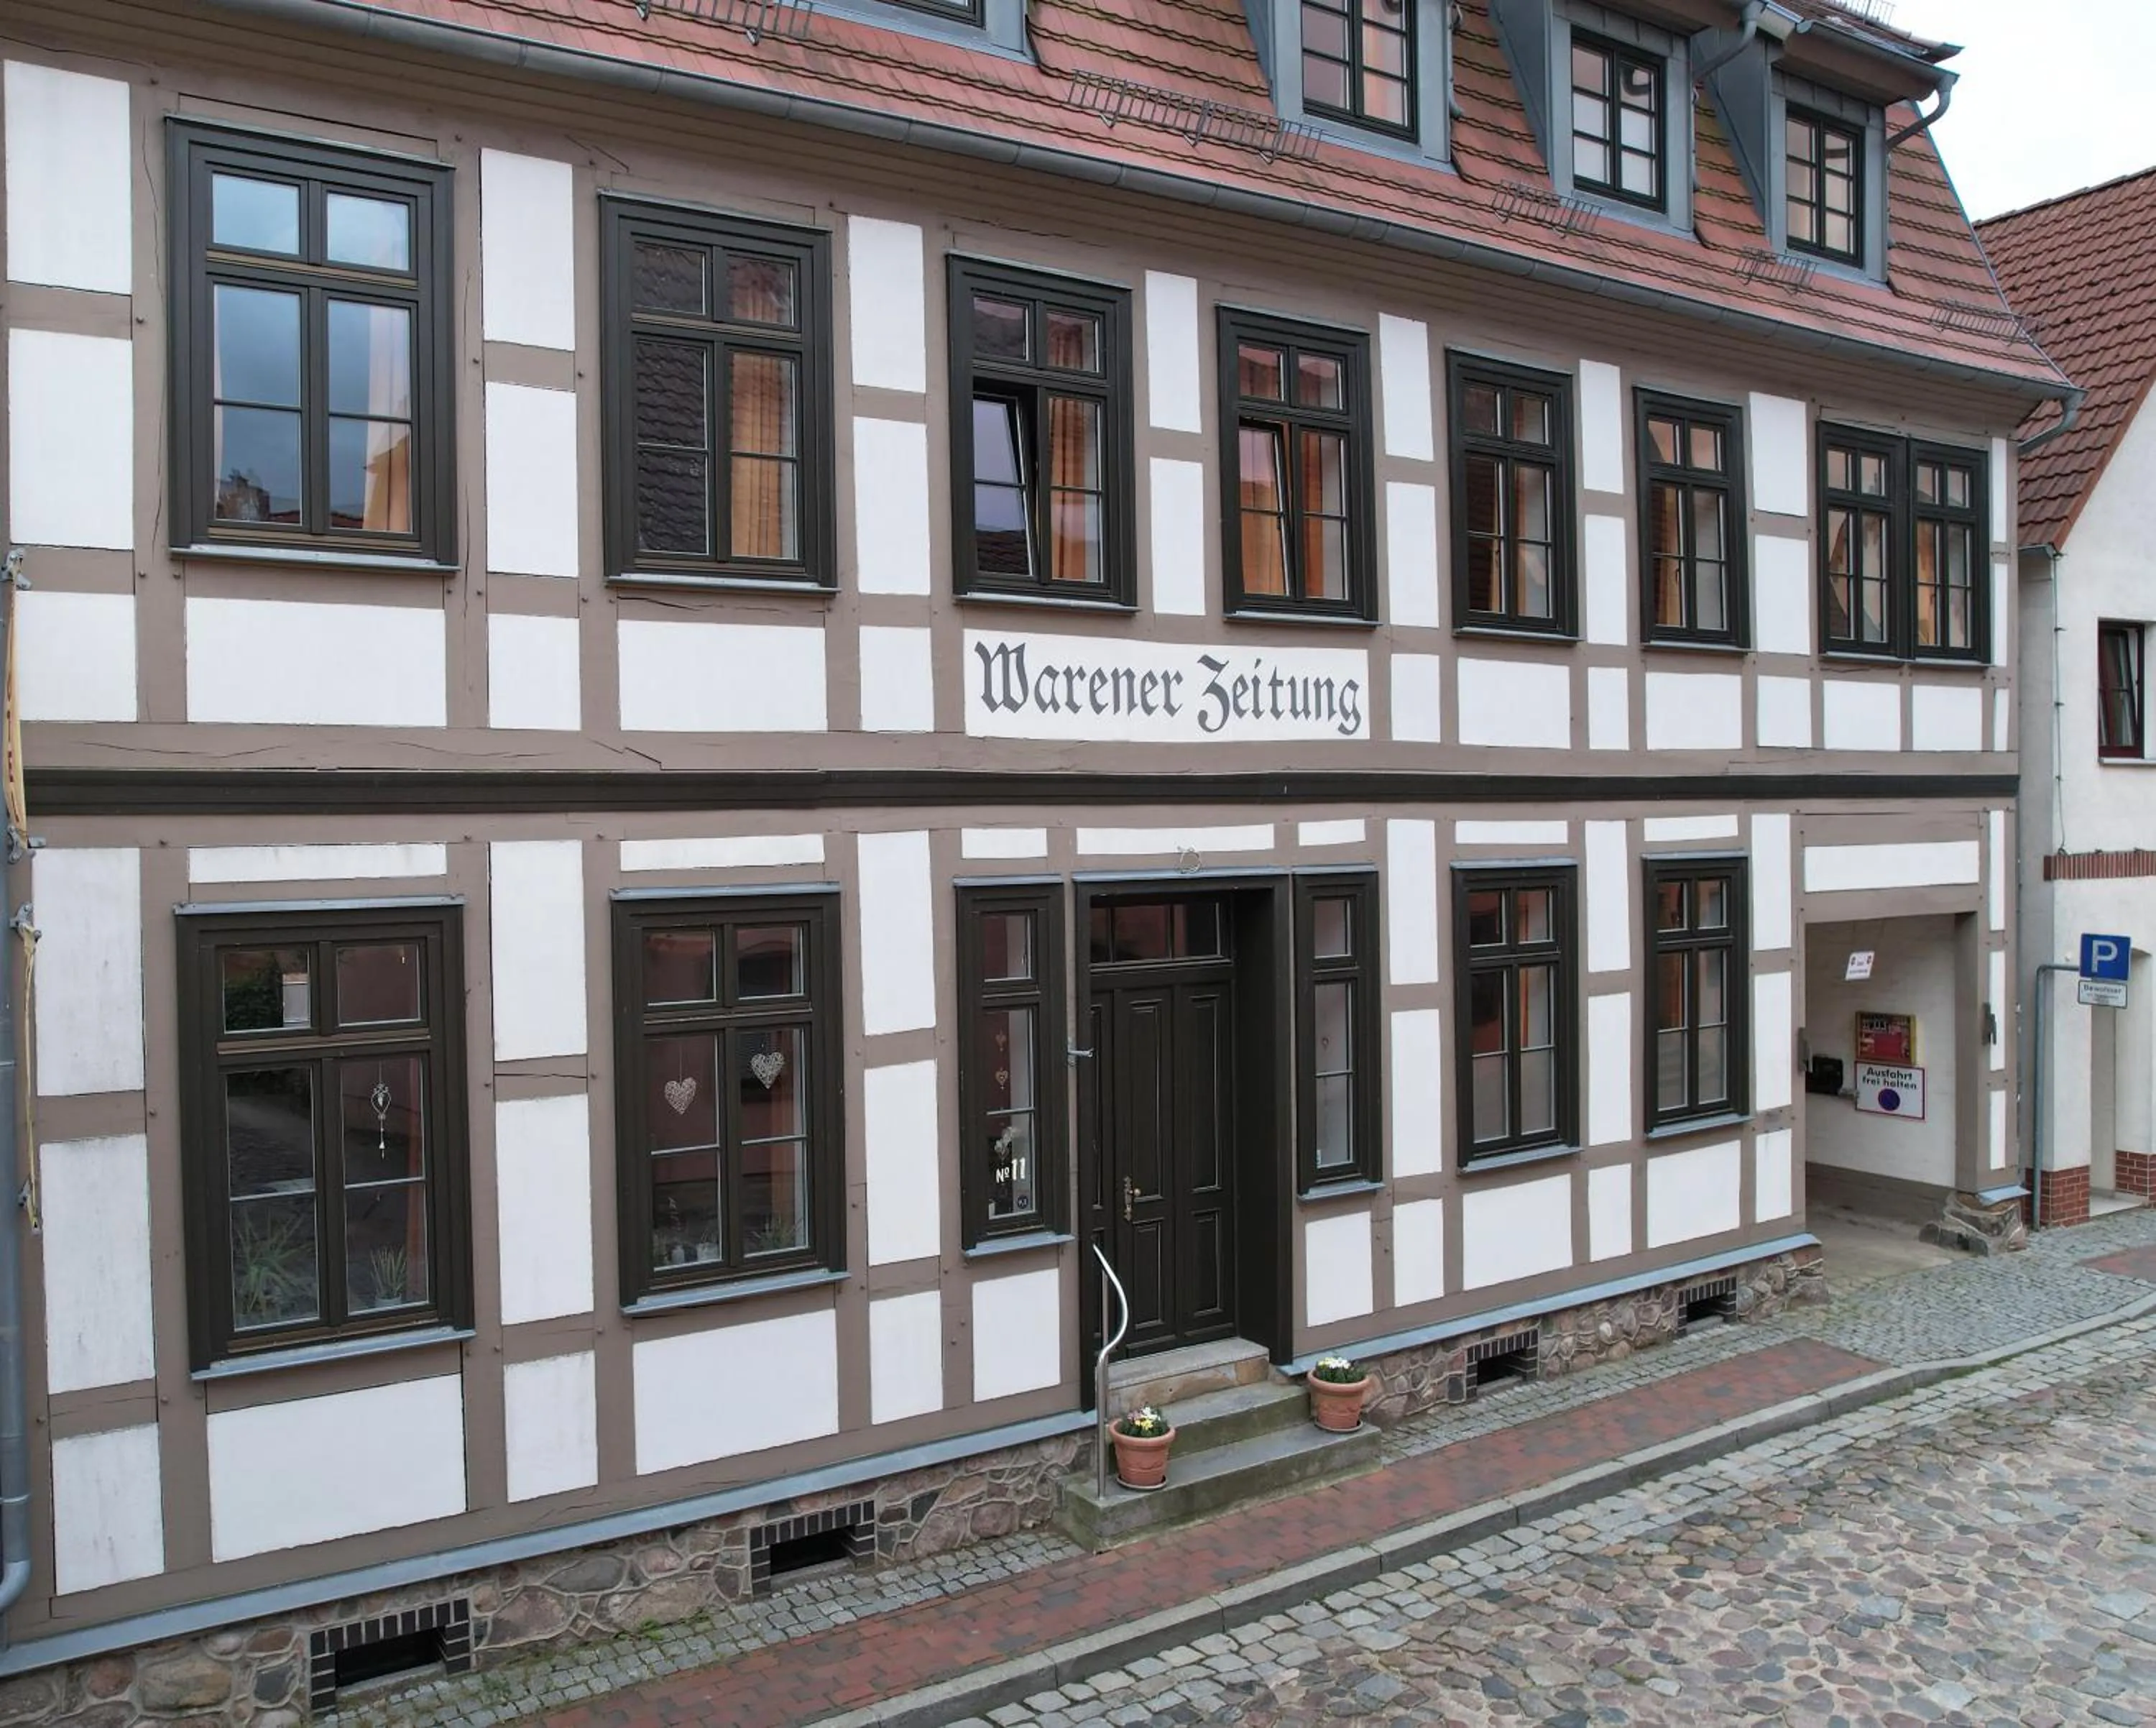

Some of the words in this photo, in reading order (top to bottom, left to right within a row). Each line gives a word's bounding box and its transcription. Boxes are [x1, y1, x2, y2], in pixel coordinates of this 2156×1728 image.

[975, 640, 1183, 717] Warener
[1196, 653, 1363, 736] Zeitung
[2091, 939, 2118, 973] P
[1862, 1075, 1880, 1086] frei
[1884, 1078, 1917, 1090] halten
[1866, 1067, 1912, 1080] Ausfahrt
